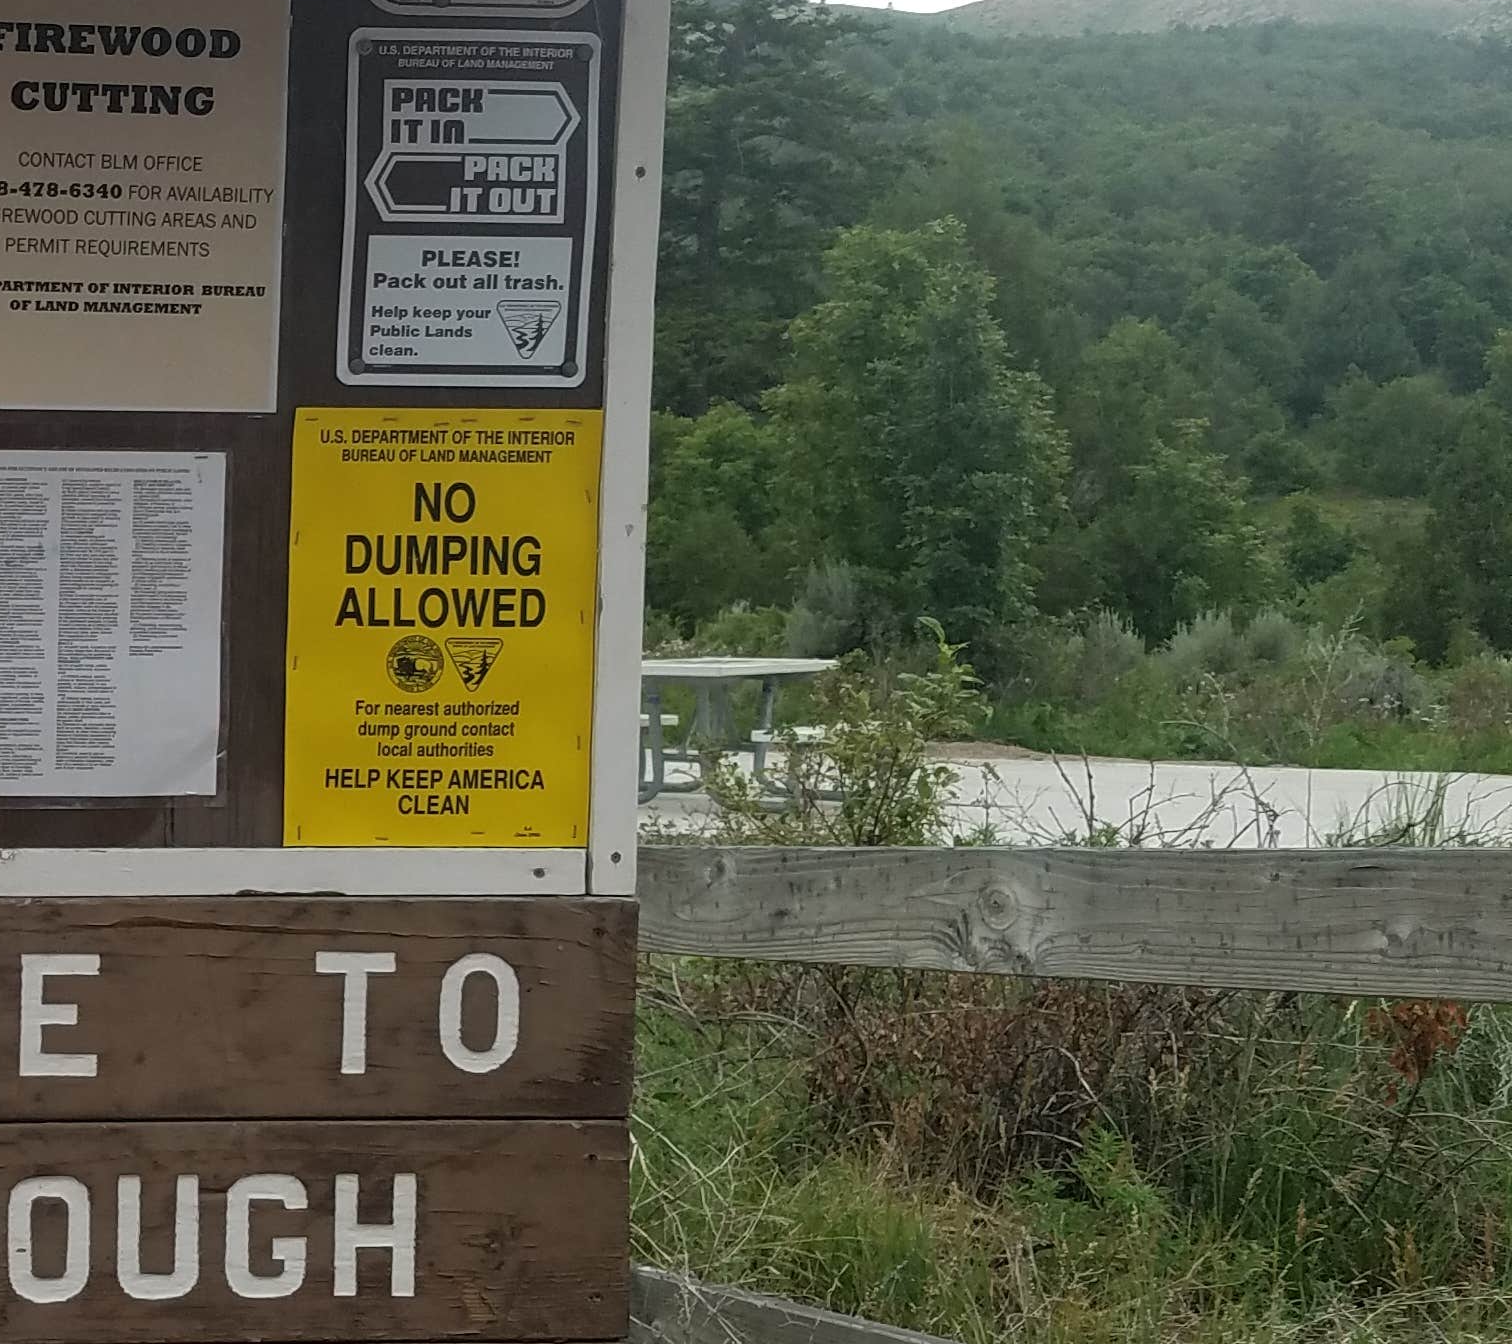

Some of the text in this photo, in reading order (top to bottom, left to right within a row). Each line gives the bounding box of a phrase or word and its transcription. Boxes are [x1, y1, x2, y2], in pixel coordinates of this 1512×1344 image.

[379, 45, 573, 59] U.S. DEPARTMENT OF THE INTERIOR
[398, 58, 555, 70] BUREAU OF LAND MANAGEMENT
[11, 81, 215, 116] CUTTING
[391, 87, 483, 113] PACK
[391, 119, 423, 144] IT
[18, 151, 203, 172] CONTACT BLM OFFICE
[464, 156, 555, 181] PACK
[128, 185, 162, 200] FOR
[166, 186, 274, 203] AVAILABILITY
[450, 187, 556, 213] IT OUT
[84, 210, 156, 227] CUTTING
[161, 212, 216, 228] AREAS
[221, 214, 257, 229] AND
[5, 237, 210, 258] PERMIT REQUIREMENTS
[422, 250, 520, 268] PLEASE!
[88, 283, 109, 293] OF
[113, 283, 194, 295] INTERIOR
[201, 285, 266, 297] BUREAU
[373, 273, 564, 290] Pack out all trash.
[10, 299, 202, 314] OF LAND MANAGEMENT
[371, 305, 491, 321] Help keep your
[370, 325, 472, 338] Public Lands
[369, 344, 418, 356] clean.
[321, 429, 575, 445] U.S. DEPARTMENT OF THE INTERIOR
[342, 449, 553, 463] BUREAU OF LAND MANAGEMENT
[414, 482, 476, 523] NO
[346, 535, 541, 576] DUMPING
[335, 587, 546, 628] ALLOWED
[355, 700, 520, 716] For nearest authorized
[358, 721, 515, 740] dump ground contact
[377, 742, 494, 757] local authorities
[325, 768, 544, 790] HELP KEEP AMERICA
[398, 795, 469, 815] CLEAN
[316, 952, 519, 1074] TO
